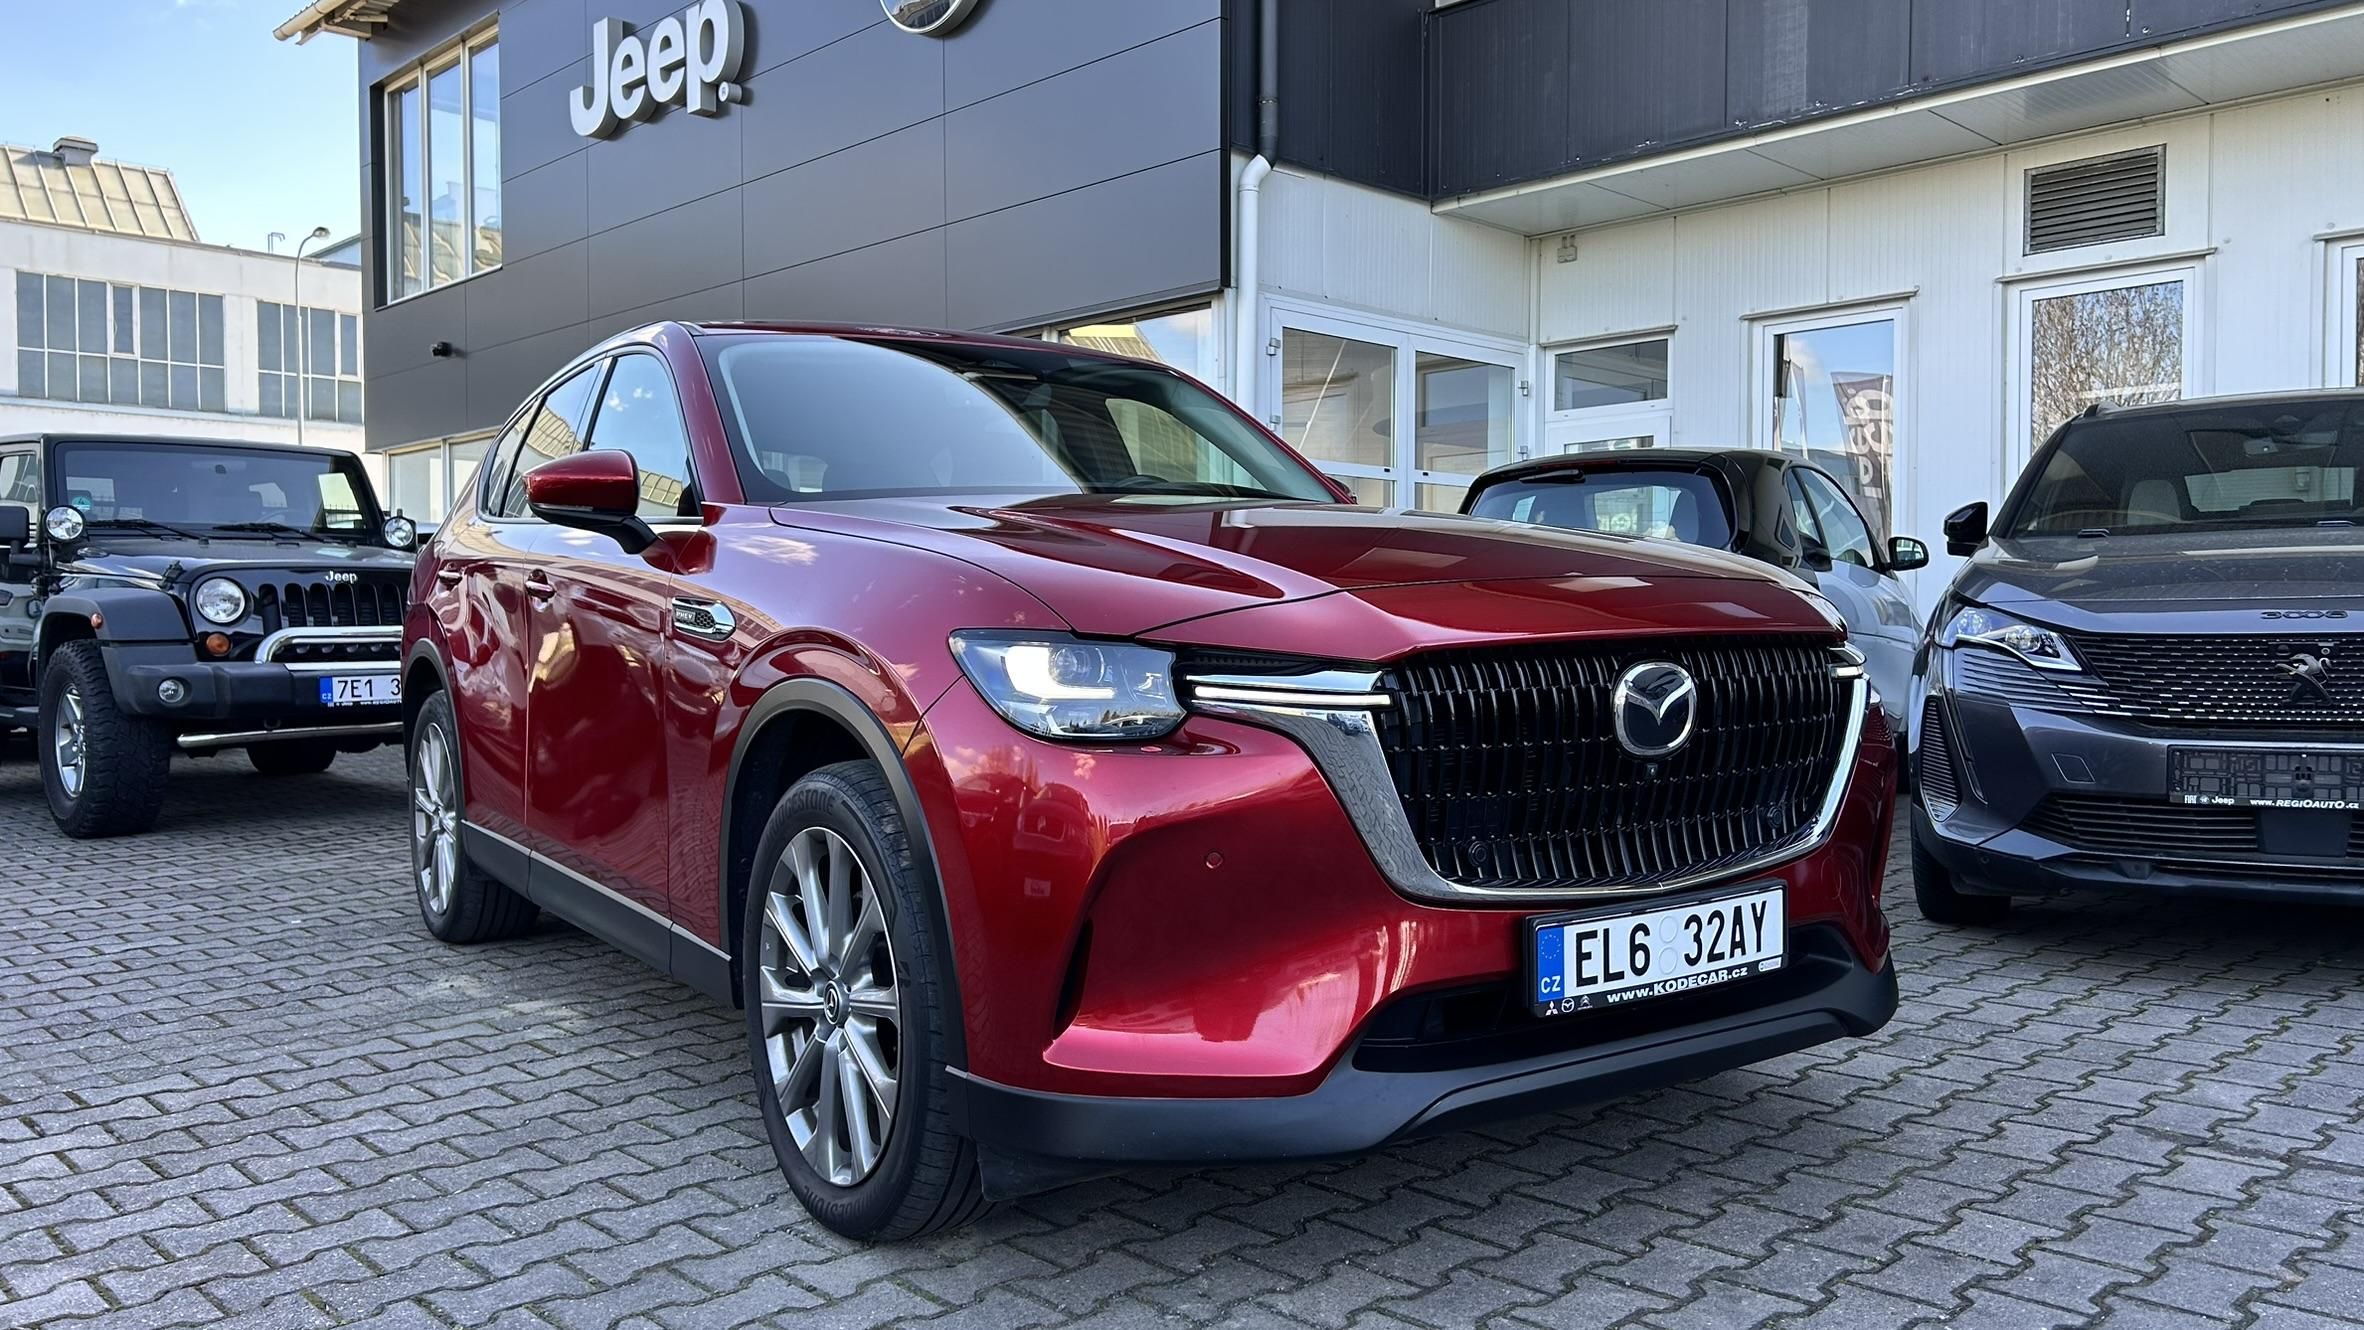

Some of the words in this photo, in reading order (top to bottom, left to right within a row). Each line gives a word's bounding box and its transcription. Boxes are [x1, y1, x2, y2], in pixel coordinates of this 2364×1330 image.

[569, 0, 743, 138] Jeep
[325, 570, 358, 584] Jeep
[2261, 610, 2348, 619] 3008
[338, 679, 374, 699] 7E1
[2184, 794, 2197, 804] FIAT
[2211, 796, 2235, 805] Jeep
[1575, 923, 1651, 988] EL6
[1683, 900, 1768, 967] 32AY
[1540, 974, 1561, 994] CZ
[1606, 966, 1748, 1004] www.KODECAR.cz
